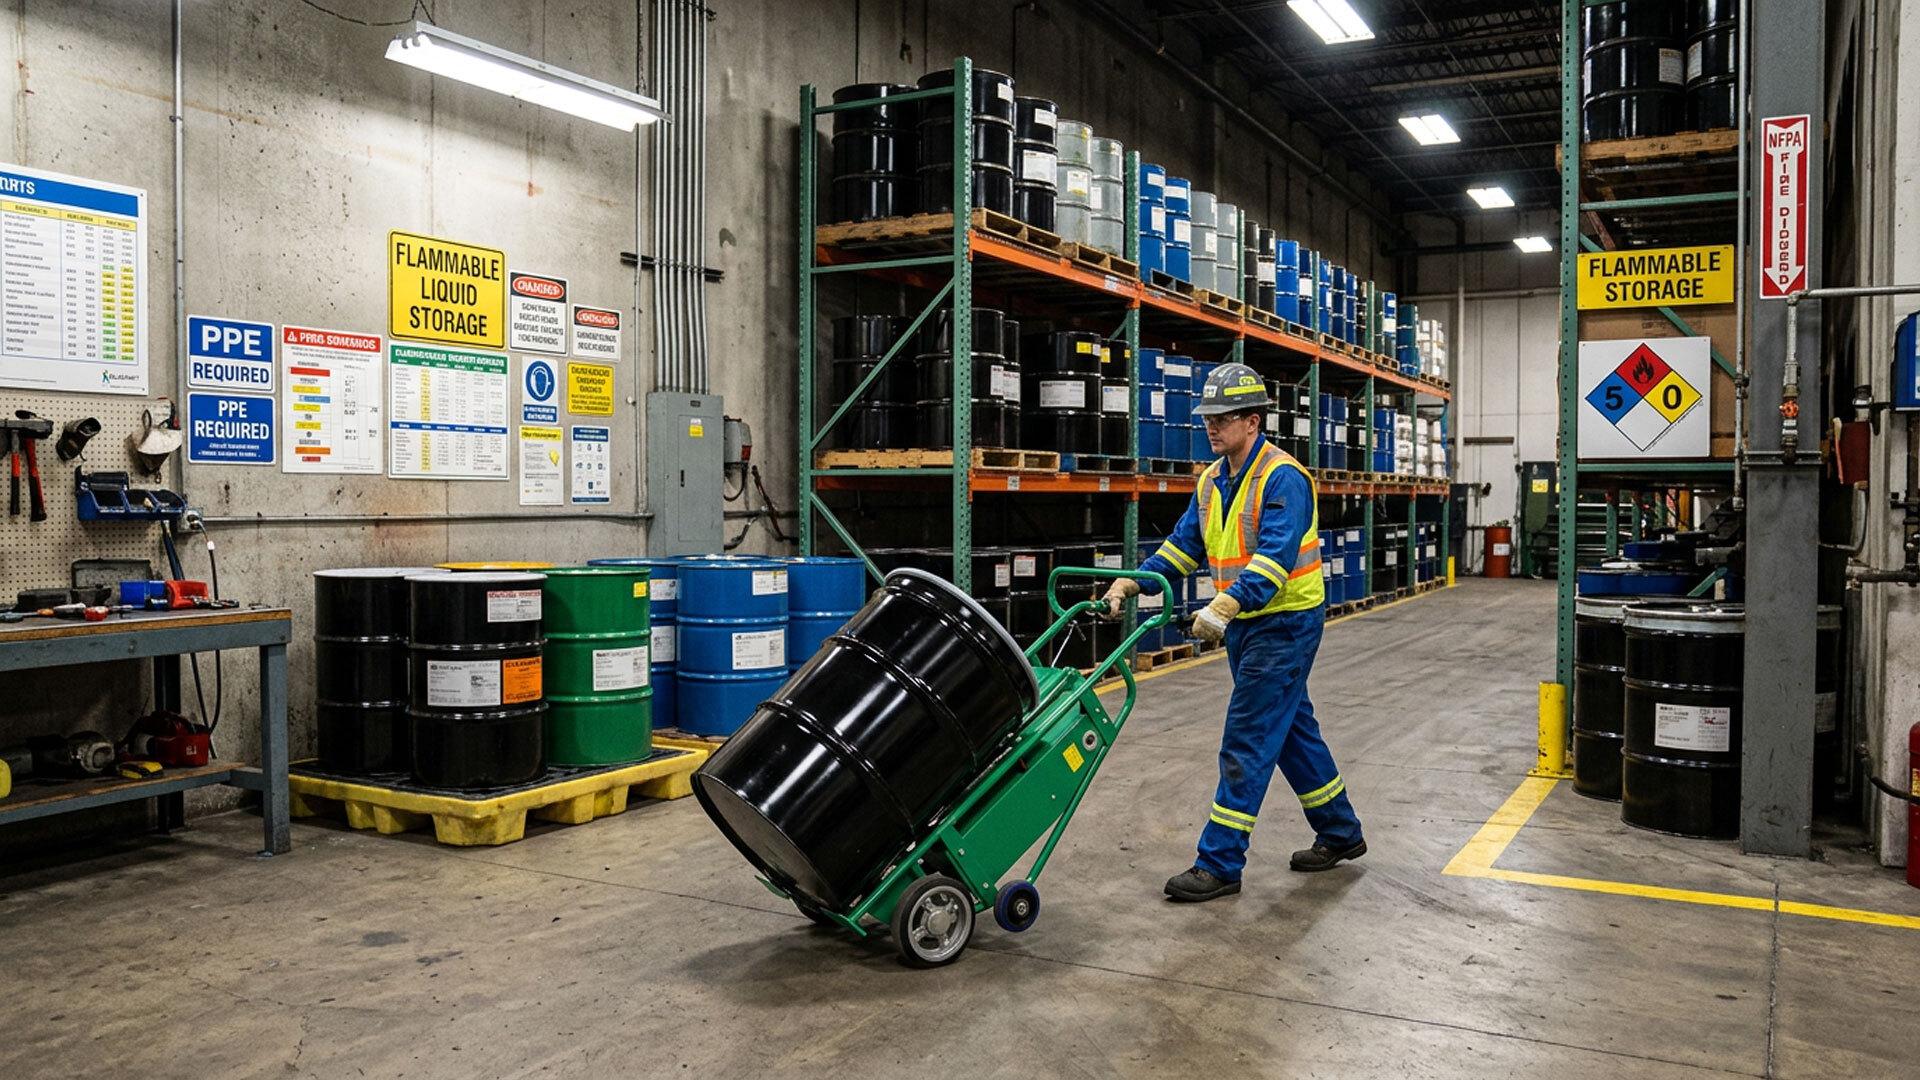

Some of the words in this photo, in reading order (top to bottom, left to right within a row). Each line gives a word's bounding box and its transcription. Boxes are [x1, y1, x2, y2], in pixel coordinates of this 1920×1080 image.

[1769, 131, 1802, 148] NFPA
[396, 242, 500, 281] FLAMMABLE
[1589, 251, 1721, 278] FLAMMABLE
[421, 276, 478, 306] LIQUID
[1605, 278, 1704, 302] STORAGE
[409, 305, 487, 337] STORAGE
[202, 325, 262, 356] PPE
[193, 362, 270, 383] REQUIRED
[218, 400, 248, 418] PPE
[1605, 385, 1624, 411] 5
[1662, 384, 1682, 410] 0
